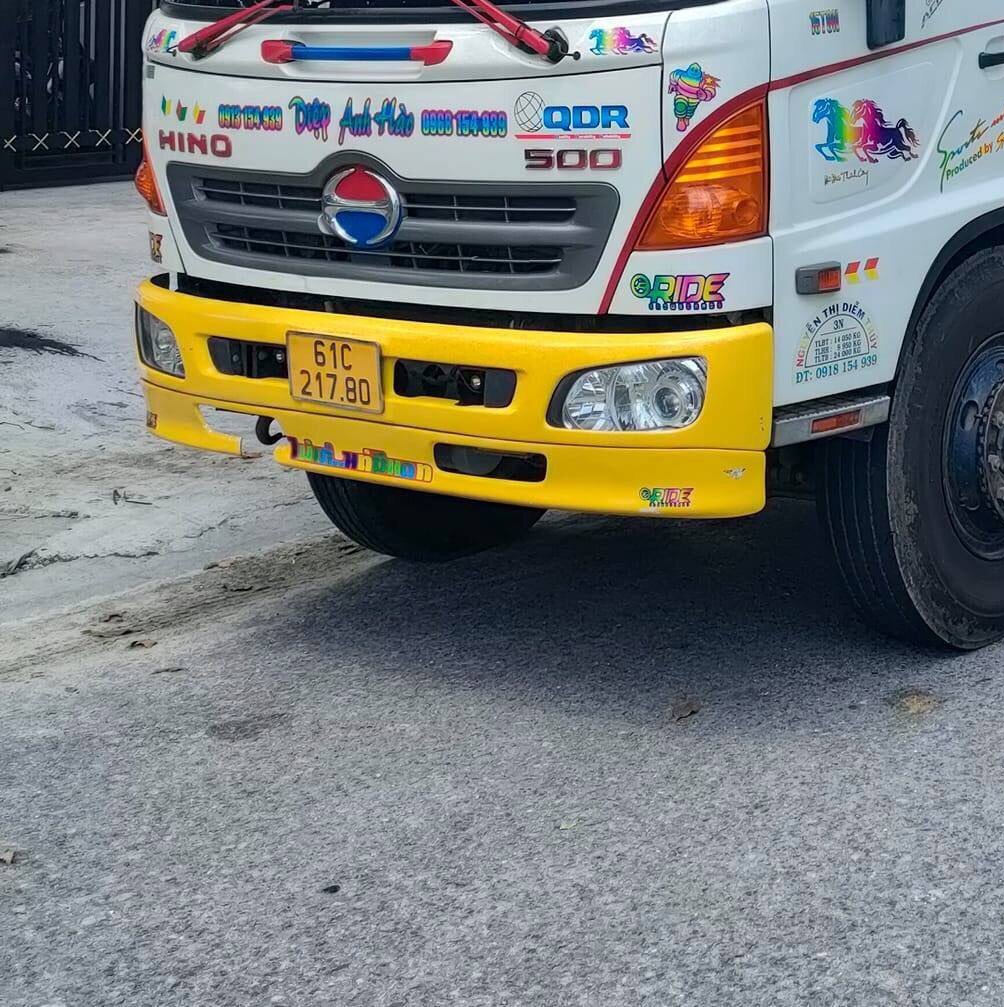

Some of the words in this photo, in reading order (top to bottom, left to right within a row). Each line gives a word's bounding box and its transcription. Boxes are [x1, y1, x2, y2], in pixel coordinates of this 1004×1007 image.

[218, 104, 241, 129] 0913
[242, 105, 261, 130] 154
[543, 104, 630, 131] QDR
[158, 128, 233, 158] HINO
[524, 148, 622, 170] 500
[946, 147, 983, 181] Produced
[982, 142, 994, 156] by
[648, 272, 731, 304] RIDE
[313, 339, 353, 371] 61C
[815, 363, 839, 379] 0918
[842, 359, 858, 373] 154
[860, 354, 878, 368] 939
[299, 368, 371, 406] 217.80
